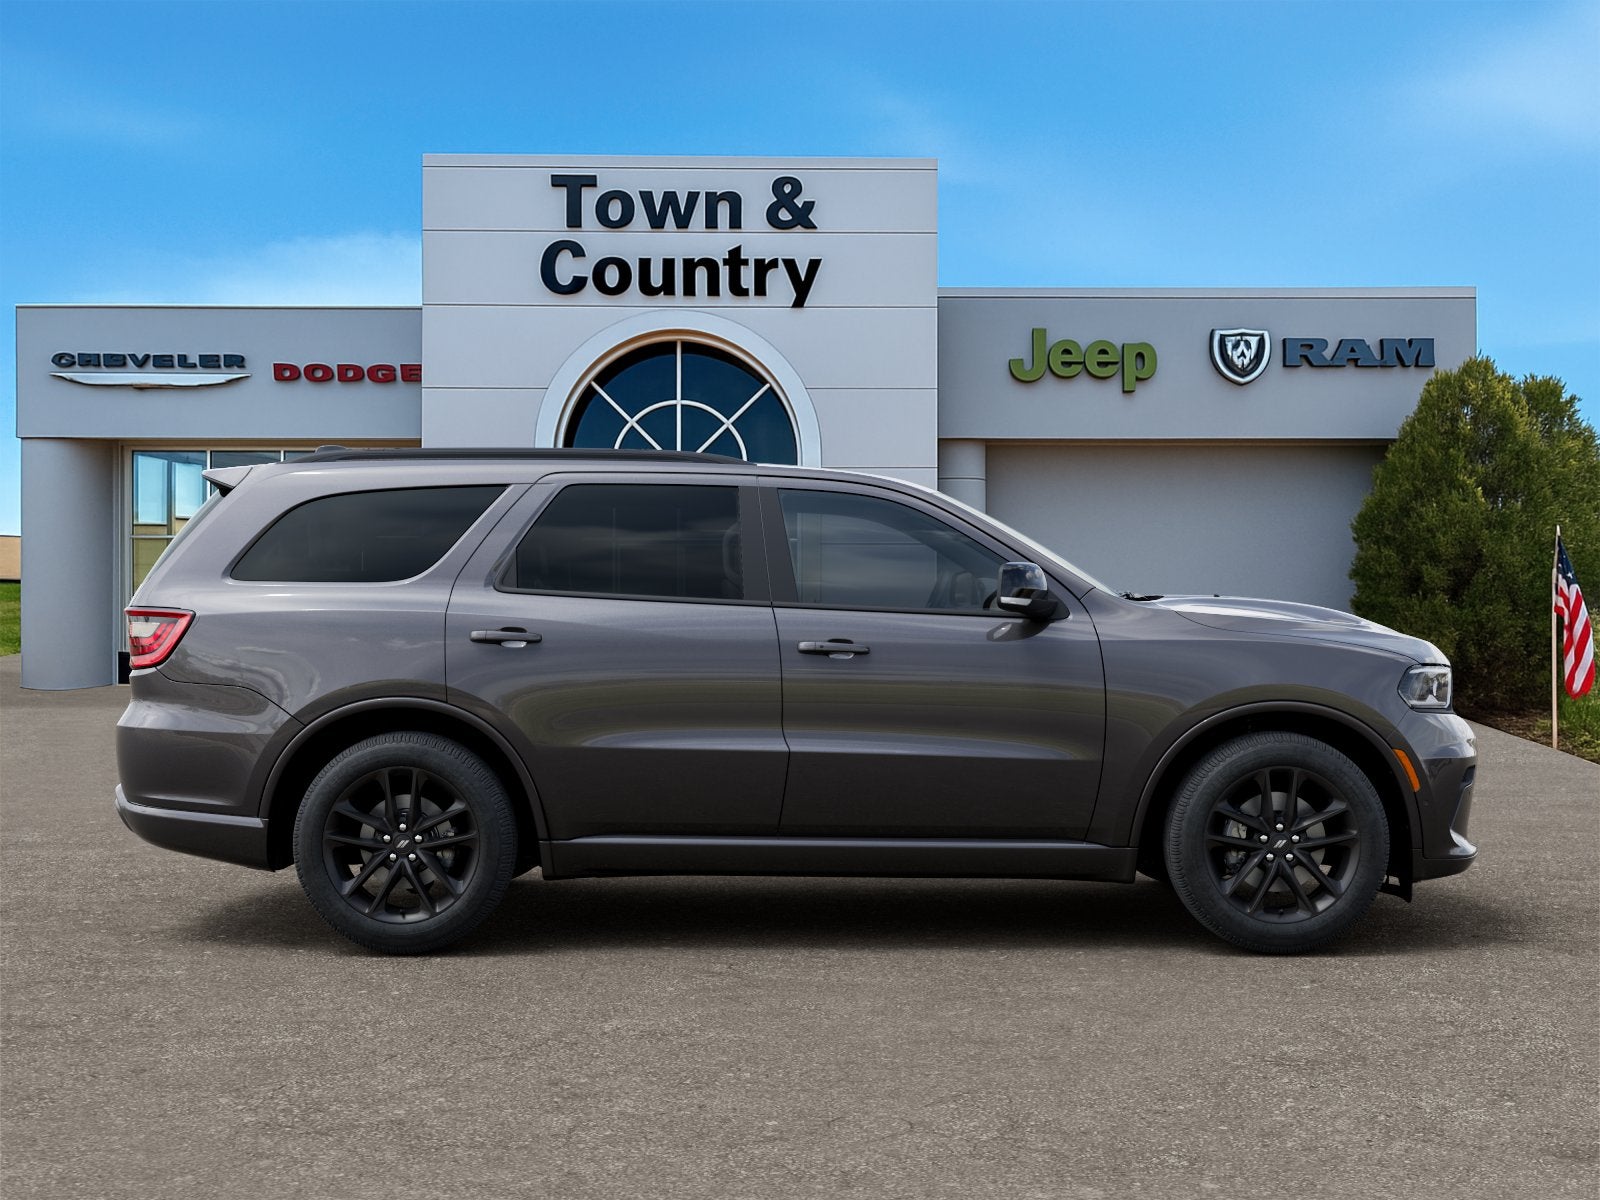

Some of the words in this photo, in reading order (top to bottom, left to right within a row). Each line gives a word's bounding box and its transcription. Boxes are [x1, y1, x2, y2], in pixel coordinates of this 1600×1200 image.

[551, 174, 742, 229] Town
[766, 176, 818, 230] &
[540, 239, 822, 308] Country
[273, 363, 422, 383] DODGE
[1009, 328, 1157, 393] Jeep
[1283, 338, 1435, 367] RAM
